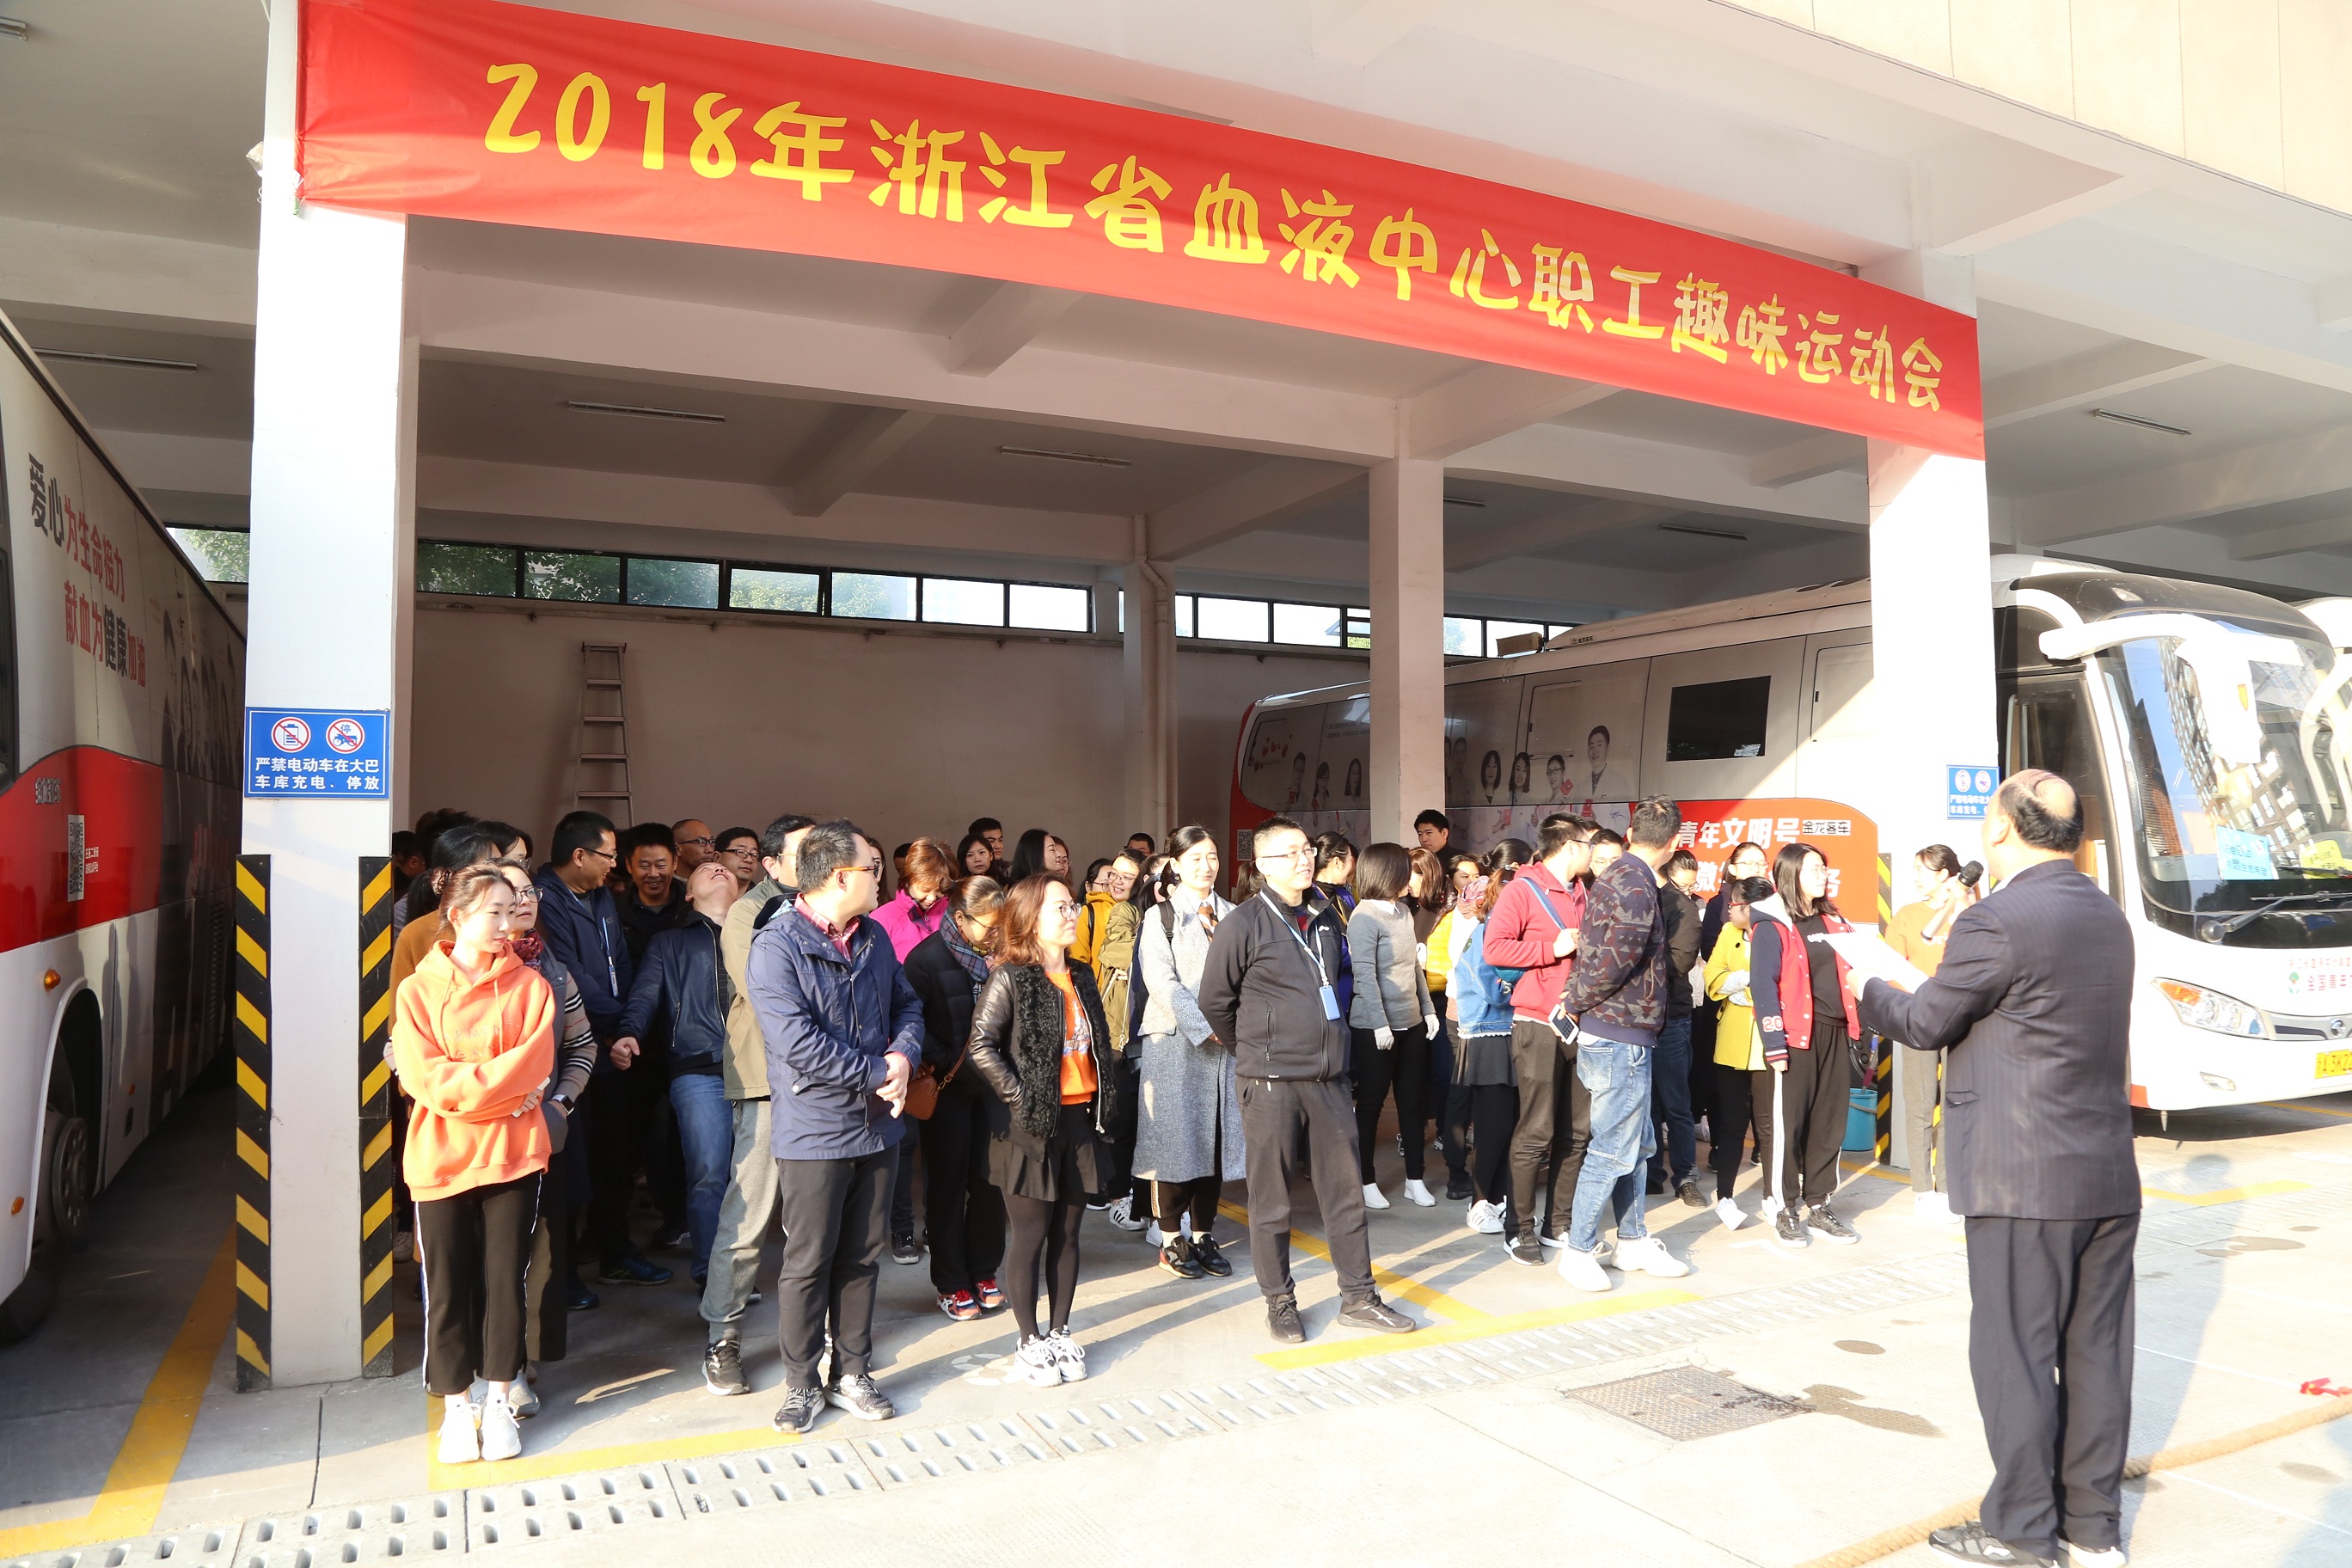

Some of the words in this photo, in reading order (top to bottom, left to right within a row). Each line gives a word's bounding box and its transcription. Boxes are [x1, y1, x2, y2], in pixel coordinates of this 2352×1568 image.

[485, 62, 1944, 412] 2018年浙江省血液中心职工趣味运动会
[28, 452, 126, 603] 爱心为生命接力
[64, 579, 146, 688] 献血为健康加油
[255, 757, 379, 773] 严禁电动车在大巴
[255, 775, 379, 790] 车库充电、停放
[1802, 819, 1851, 836] 金龙客车
